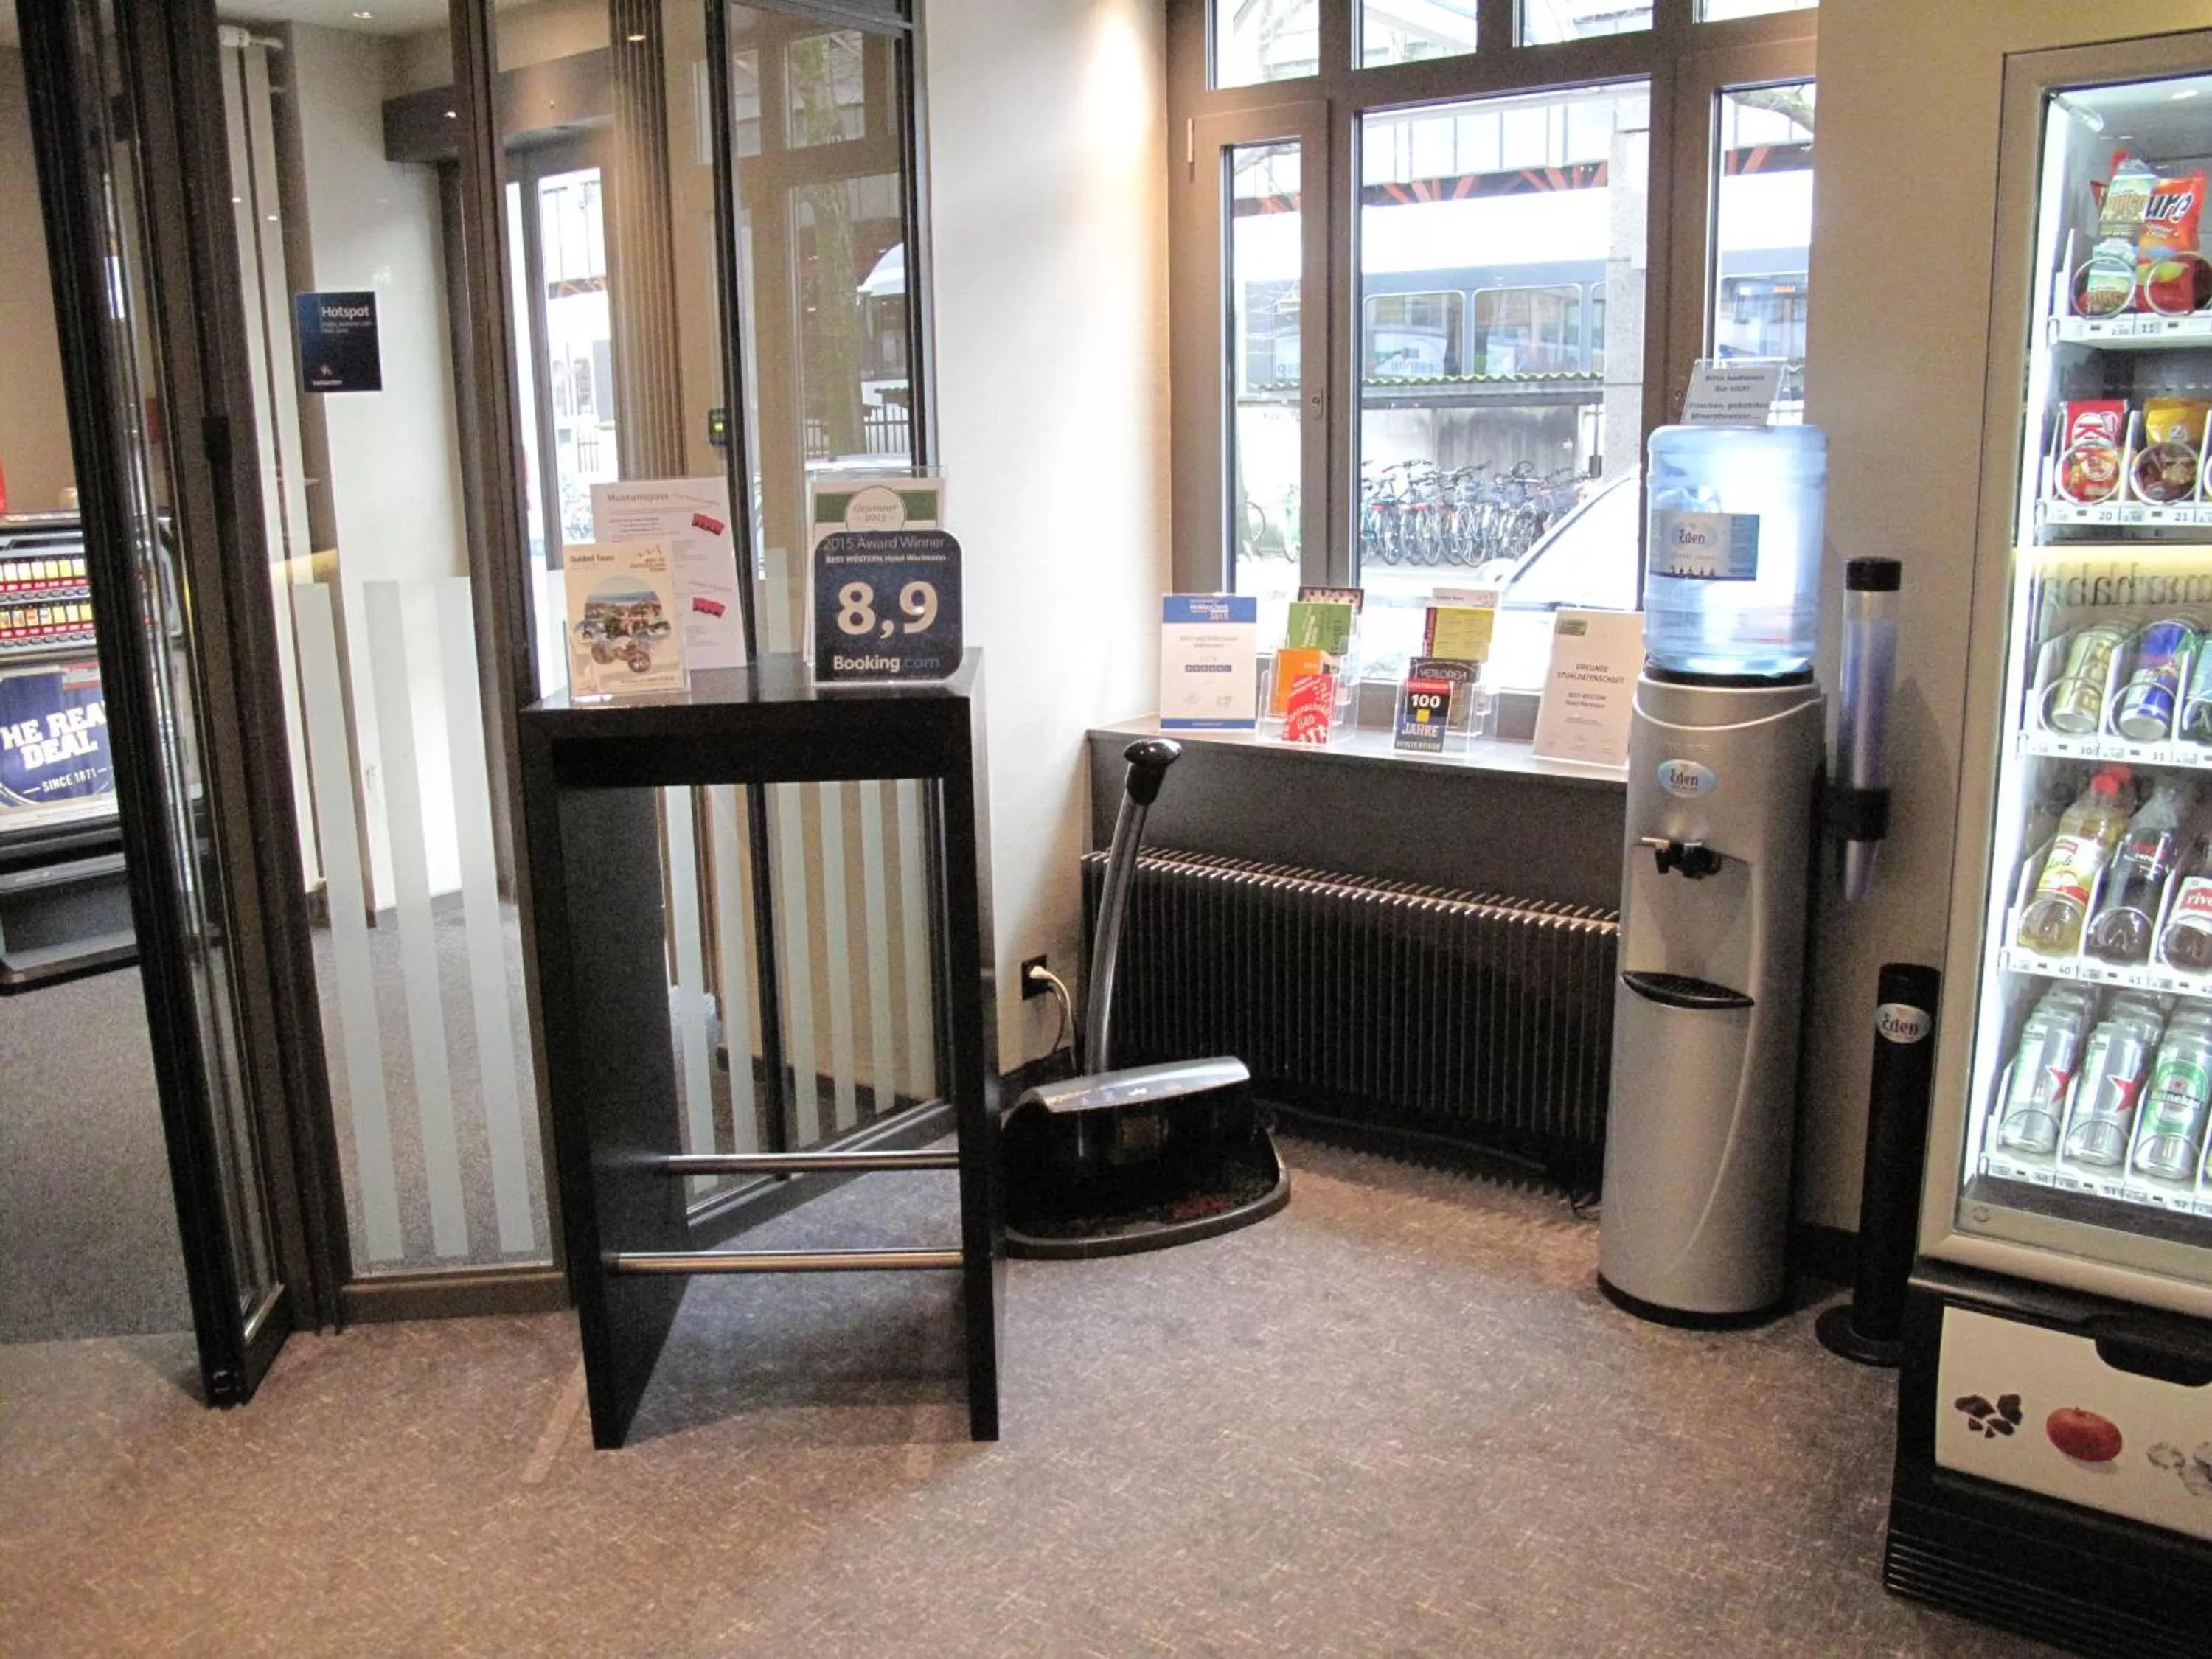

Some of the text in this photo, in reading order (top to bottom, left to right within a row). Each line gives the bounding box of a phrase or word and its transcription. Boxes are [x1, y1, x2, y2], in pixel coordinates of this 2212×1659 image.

[321, 306, 370, 320] Hotspot
[823, 535, 945, 551] 2015 Award Winner
[1679, 528, 1705, 545] Eden
[825, 555, 844, 563] BEST
[837, 580, 939, 639] 8,9
[832, 654, 940, 674] Booking.com
[1411, 694, 1441, 708] 100
[0, 719, 44, 751] HE
[1402, 721, 1440, 737] JAHRE
[20, 731, 99, 771] DEAL
[41, 767, 97, 793] SINCE 1871
[1670, 768, 1699, 786] Eden
[1881, 1012, 1919, 1036] Eden
